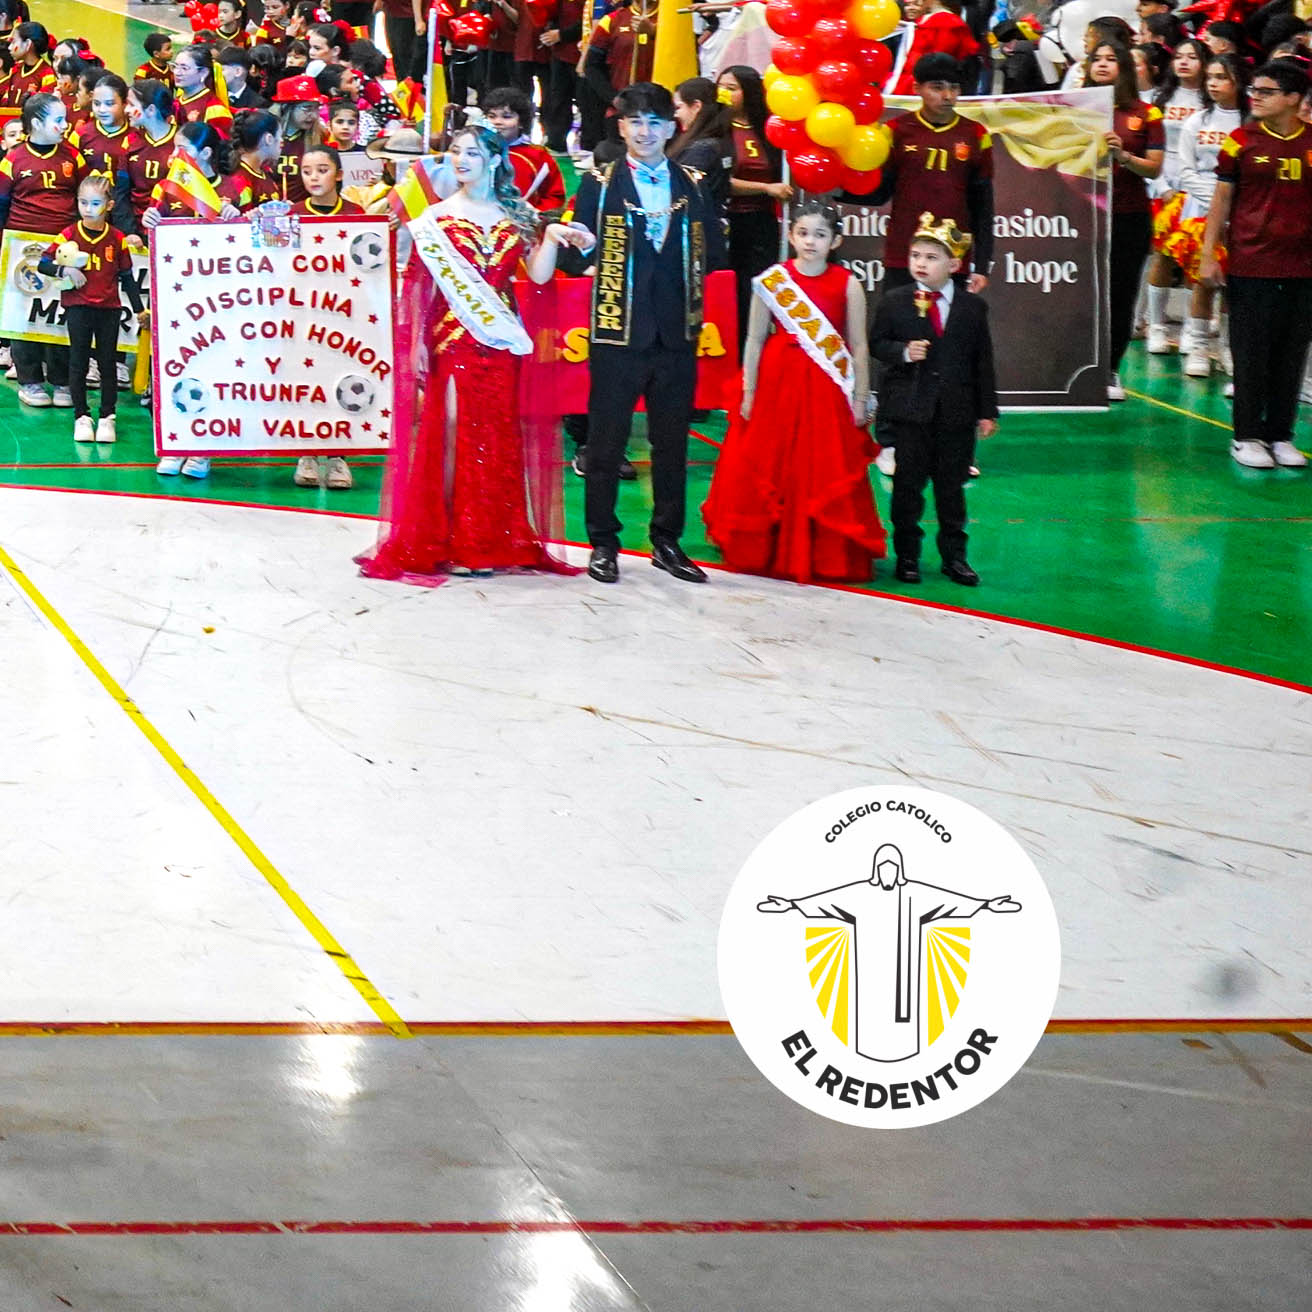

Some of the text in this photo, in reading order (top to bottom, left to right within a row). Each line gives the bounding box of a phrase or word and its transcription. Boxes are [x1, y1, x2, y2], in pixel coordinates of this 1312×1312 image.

[1197, 130, 1228, 145] ESP
[40, 171, 56, 189] 12
[145, 159, 159, 179] 13
[1277, 157, 1303, 181] 20
[180, 254, 346, 278] JUEGA CON
[1005, 251, 1079, 293] hope
[596, 226, 627, 331] REDENTOR
[184, 287, 353, 322] DISCIPLINA
[163, 319, 392, 382] GANA CON HONOR
[264, 356, 282, 376] Y
[212, 382, 327, 404] TRIUNFA
[190, 417, 353, 440] CON VALOR
